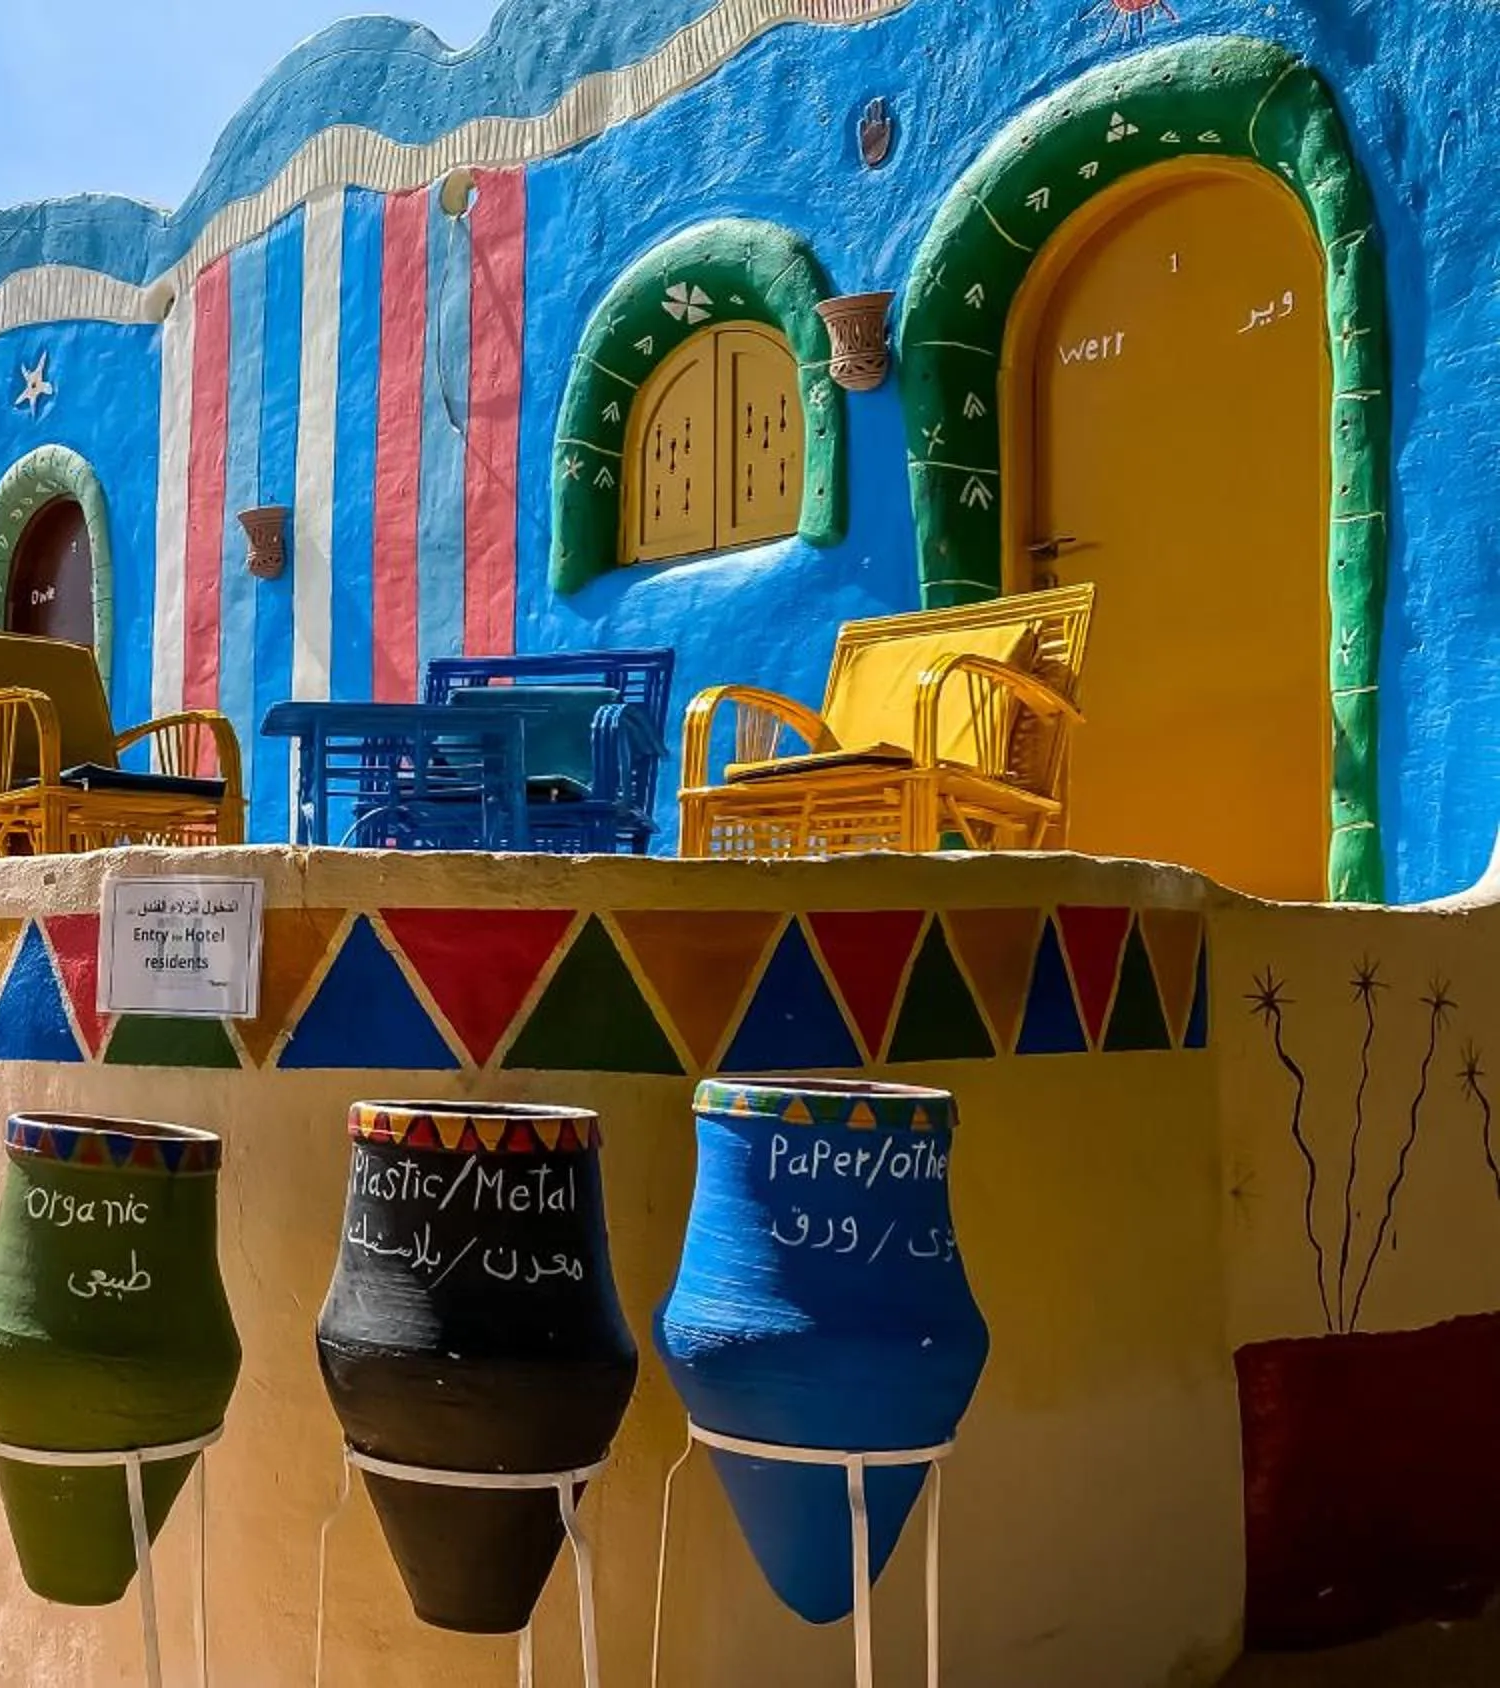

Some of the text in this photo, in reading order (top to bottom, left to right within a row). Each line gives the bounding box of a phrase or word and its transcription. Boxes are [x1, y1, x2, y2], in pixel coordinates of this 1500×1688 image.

[1168, 252, 1181, 273] 1
[133, 927, 169, 945] Entry
[185, 926, 225, 943] Hotel
[145, 953, 209, 970] residents
[23, 1186, 149, 1228] Organic
